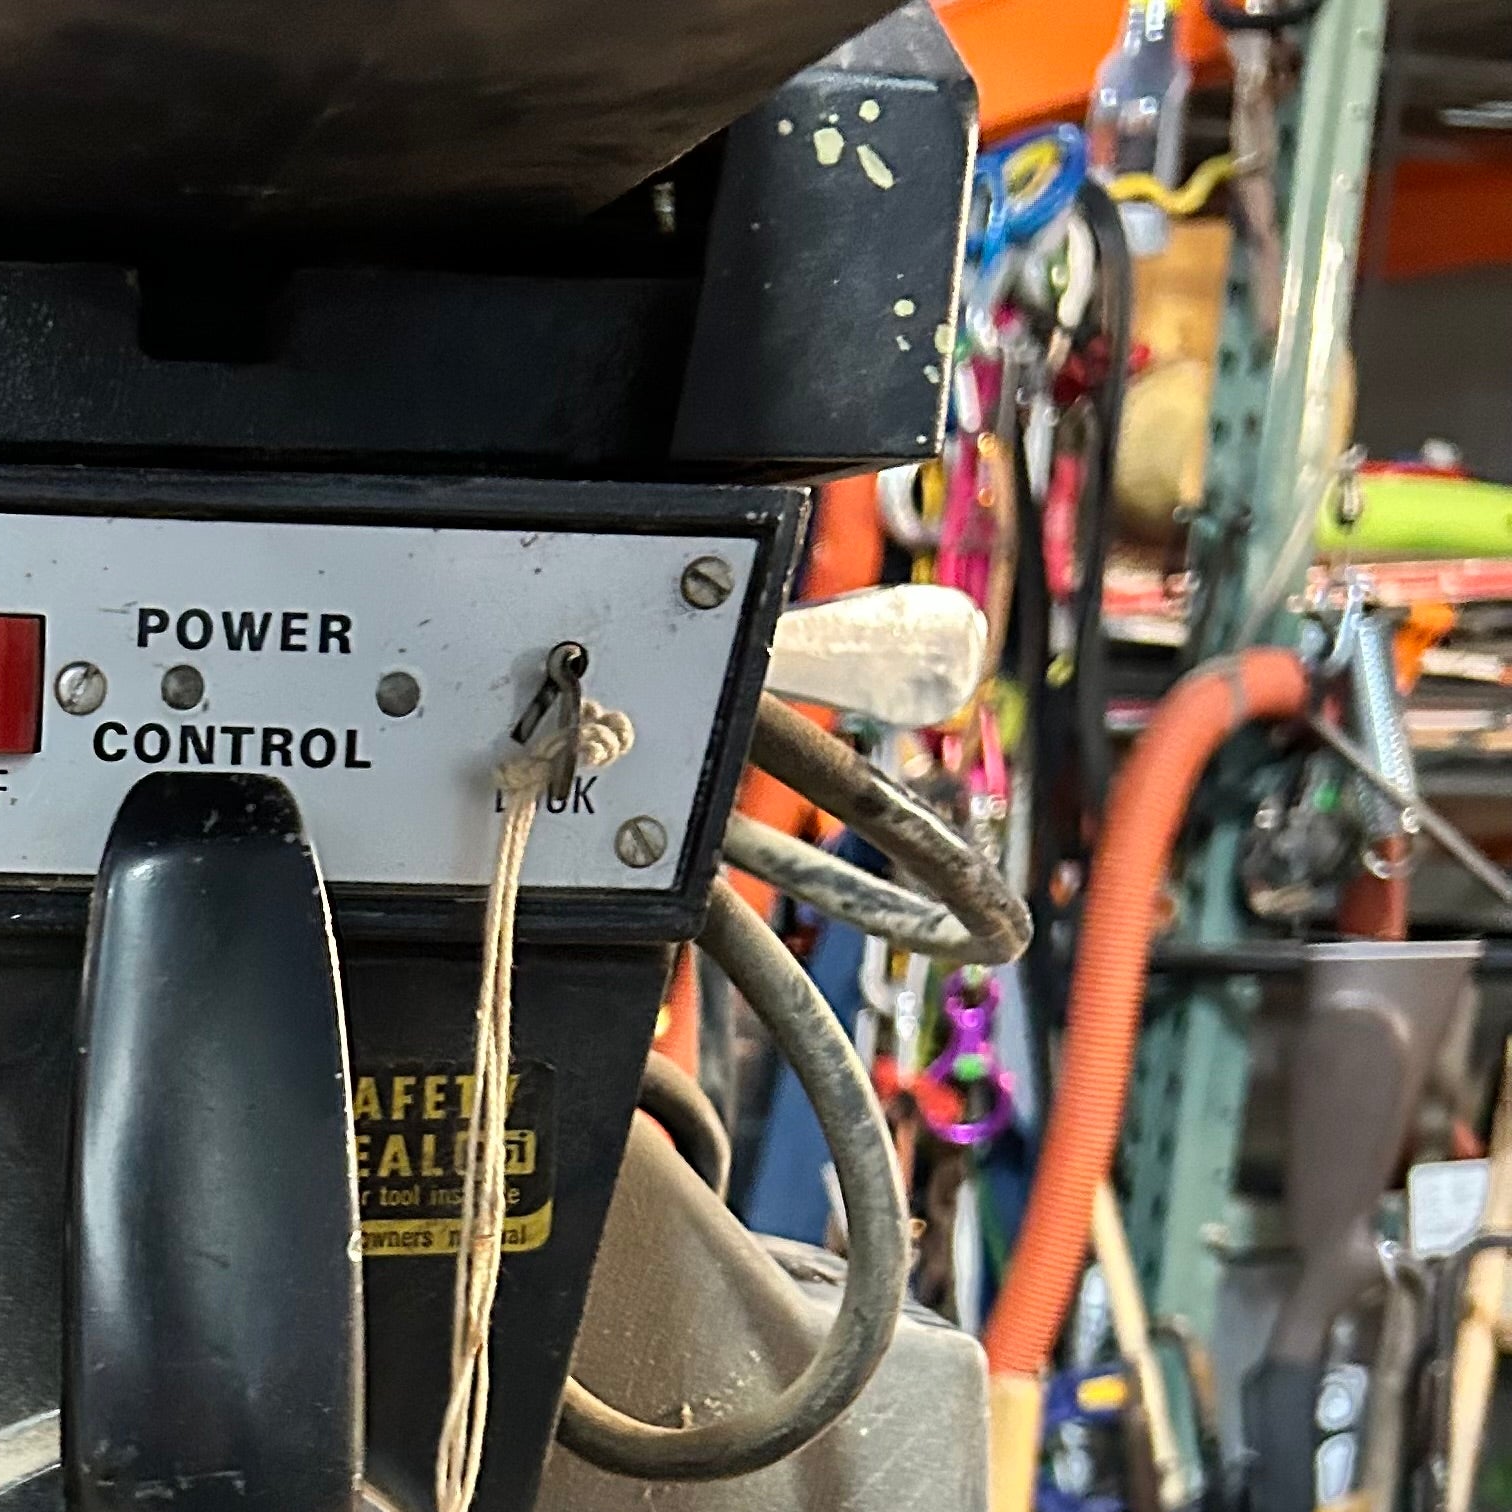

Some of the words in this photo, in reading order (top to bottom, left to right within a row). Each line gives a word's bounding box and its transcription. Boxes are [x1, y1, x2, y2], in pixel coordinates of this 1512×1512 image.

[137, 607, 352, 654] POWER
[93, 721, 372, 768] CONTROL
[495, 775, 598, 814] LCK
[354, 1074, 521, 1120] AFET
[354, 1133, 444, 1177] EAL
[379, 1184, 420, 1206] tool
